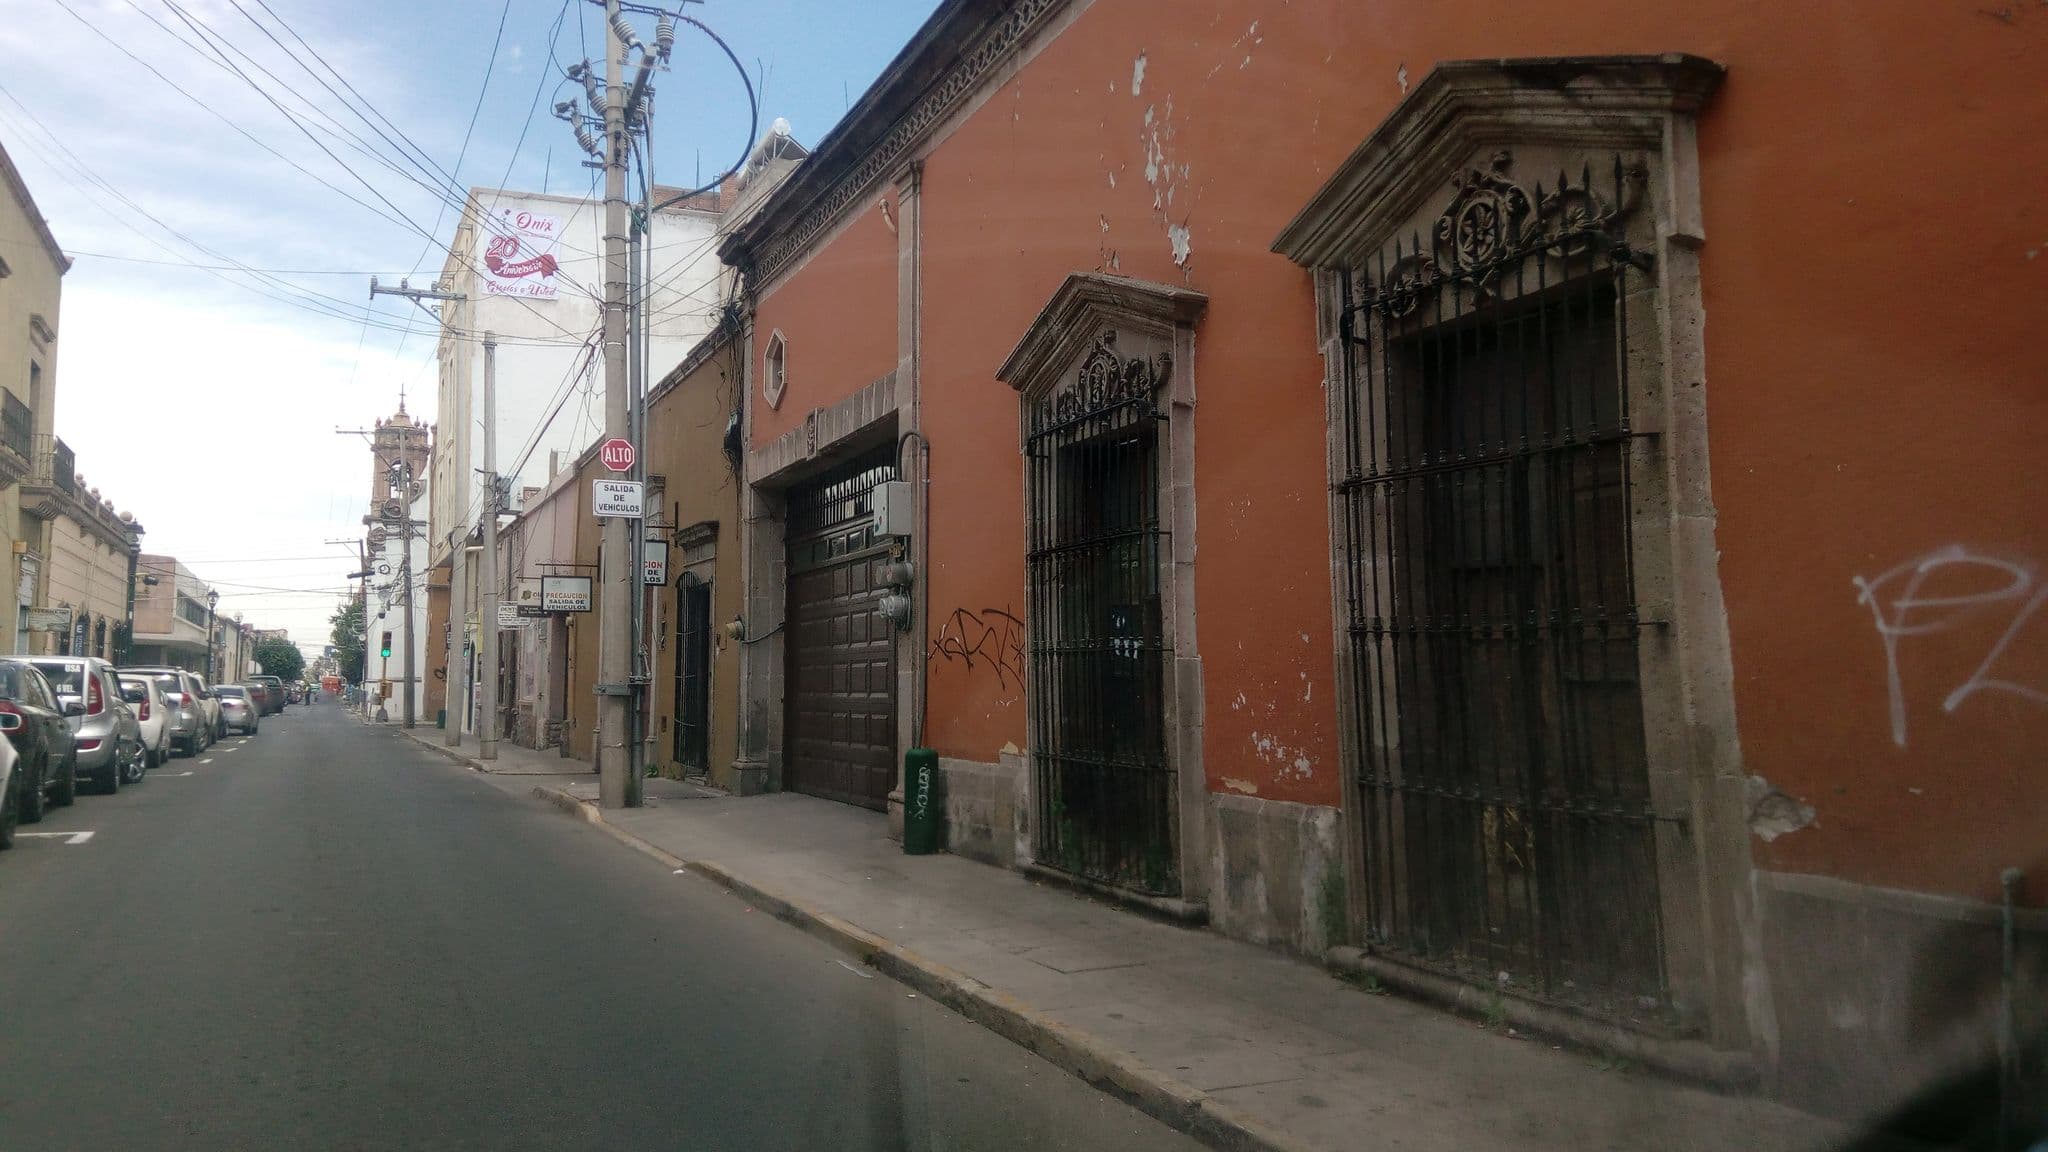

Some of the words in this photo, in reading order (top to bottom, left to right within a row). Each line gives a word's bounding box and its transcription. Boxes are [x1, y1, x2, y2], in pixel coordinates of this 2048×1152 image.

[516, 212, 552, 231] Onix
[487, 235, 520, 259] 20
[605, 447, 631, 462] ALTO
[604, 484, 634, 493] SALIDA
[613, 494, 625, 502] DE
[599, 504, 640, 512] VEHICULOS
[64, 664, 81, 673] USA
